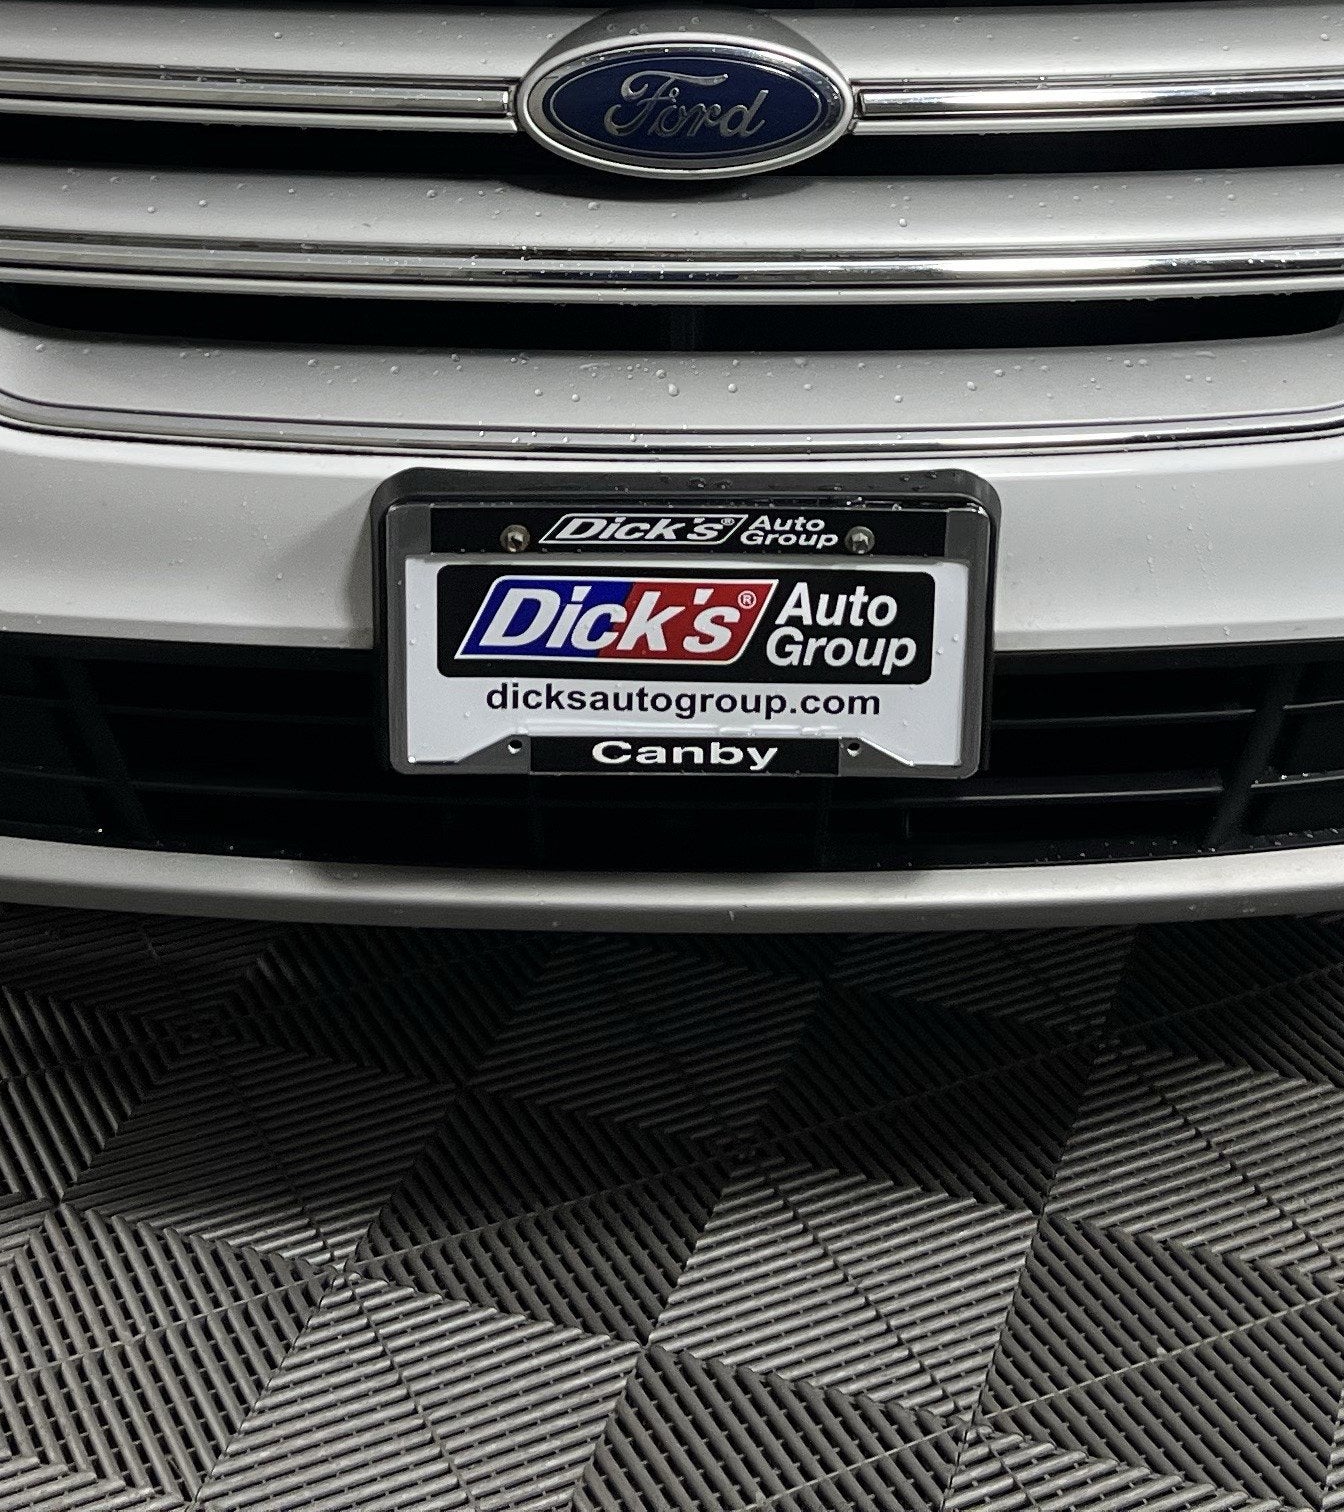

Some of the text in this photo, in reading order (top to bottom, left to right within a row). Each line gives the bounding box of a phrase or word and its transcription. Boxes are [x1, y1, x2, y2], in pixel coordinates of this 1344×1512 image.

[602, 69, 769, 138] Ford
[740, 529, 839, 550] Group
[749, 514, 826, 533] Auto
[774, 582, 898, 627] Auto
[766, 626, 917, 676] Group
[486, 682, 881, 721] dicksautogroup.com
[591, 740, 779, 771] Canby
